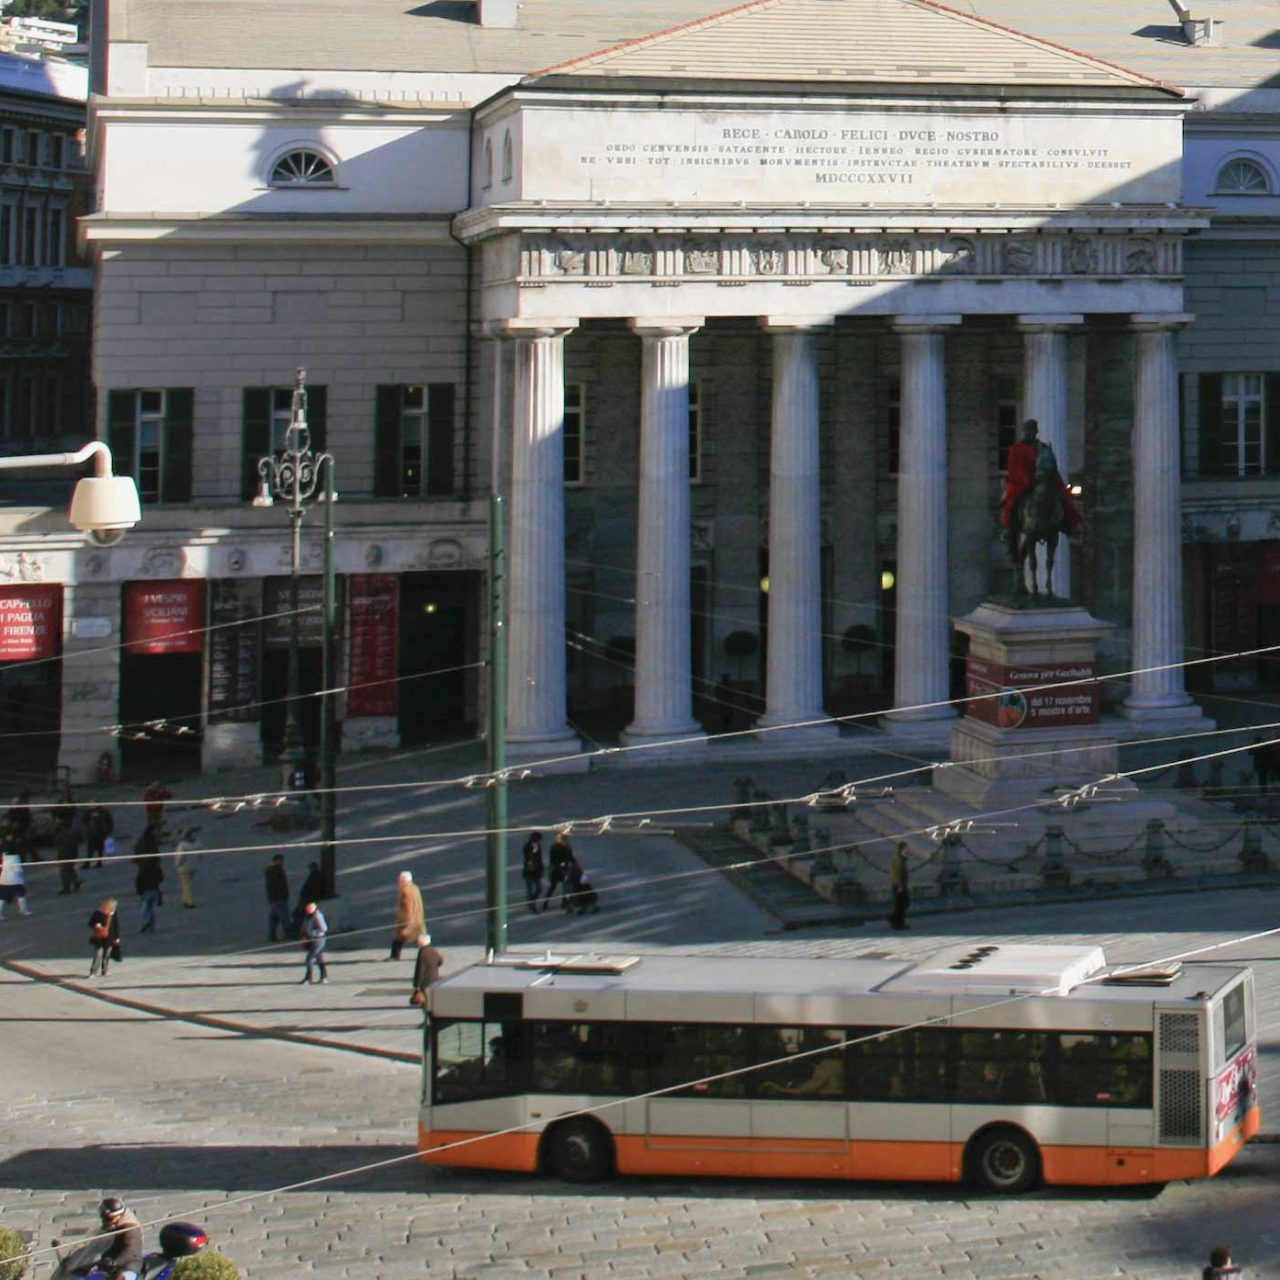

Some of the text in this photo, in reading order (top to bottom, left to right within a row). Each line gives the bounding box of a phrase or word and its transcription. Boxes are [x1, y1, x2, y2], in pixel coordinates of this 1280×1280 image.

[774, 128, 829, 141] CAROLO
[840, 129, 888, 142] FELICI
[899, 130, 937, 142] DVCE
[947, 130, 999, 142] NOSTRO
[606, 144, 636, 152] ORDO
[649, 156, 670, 165] TOT
[926, 159, 990, 168] THEATRVM
[815, 172, 914, 185] MDCCCXXVII
[0, 598, 52, 609] CAPPELLO
[7, 612, 45, 623] PAGLIA
[4, 625, 49, 636] FIRENZE
[1040, 671, 1054, 680] per
[1055, 695, 1092, 704] novembre
